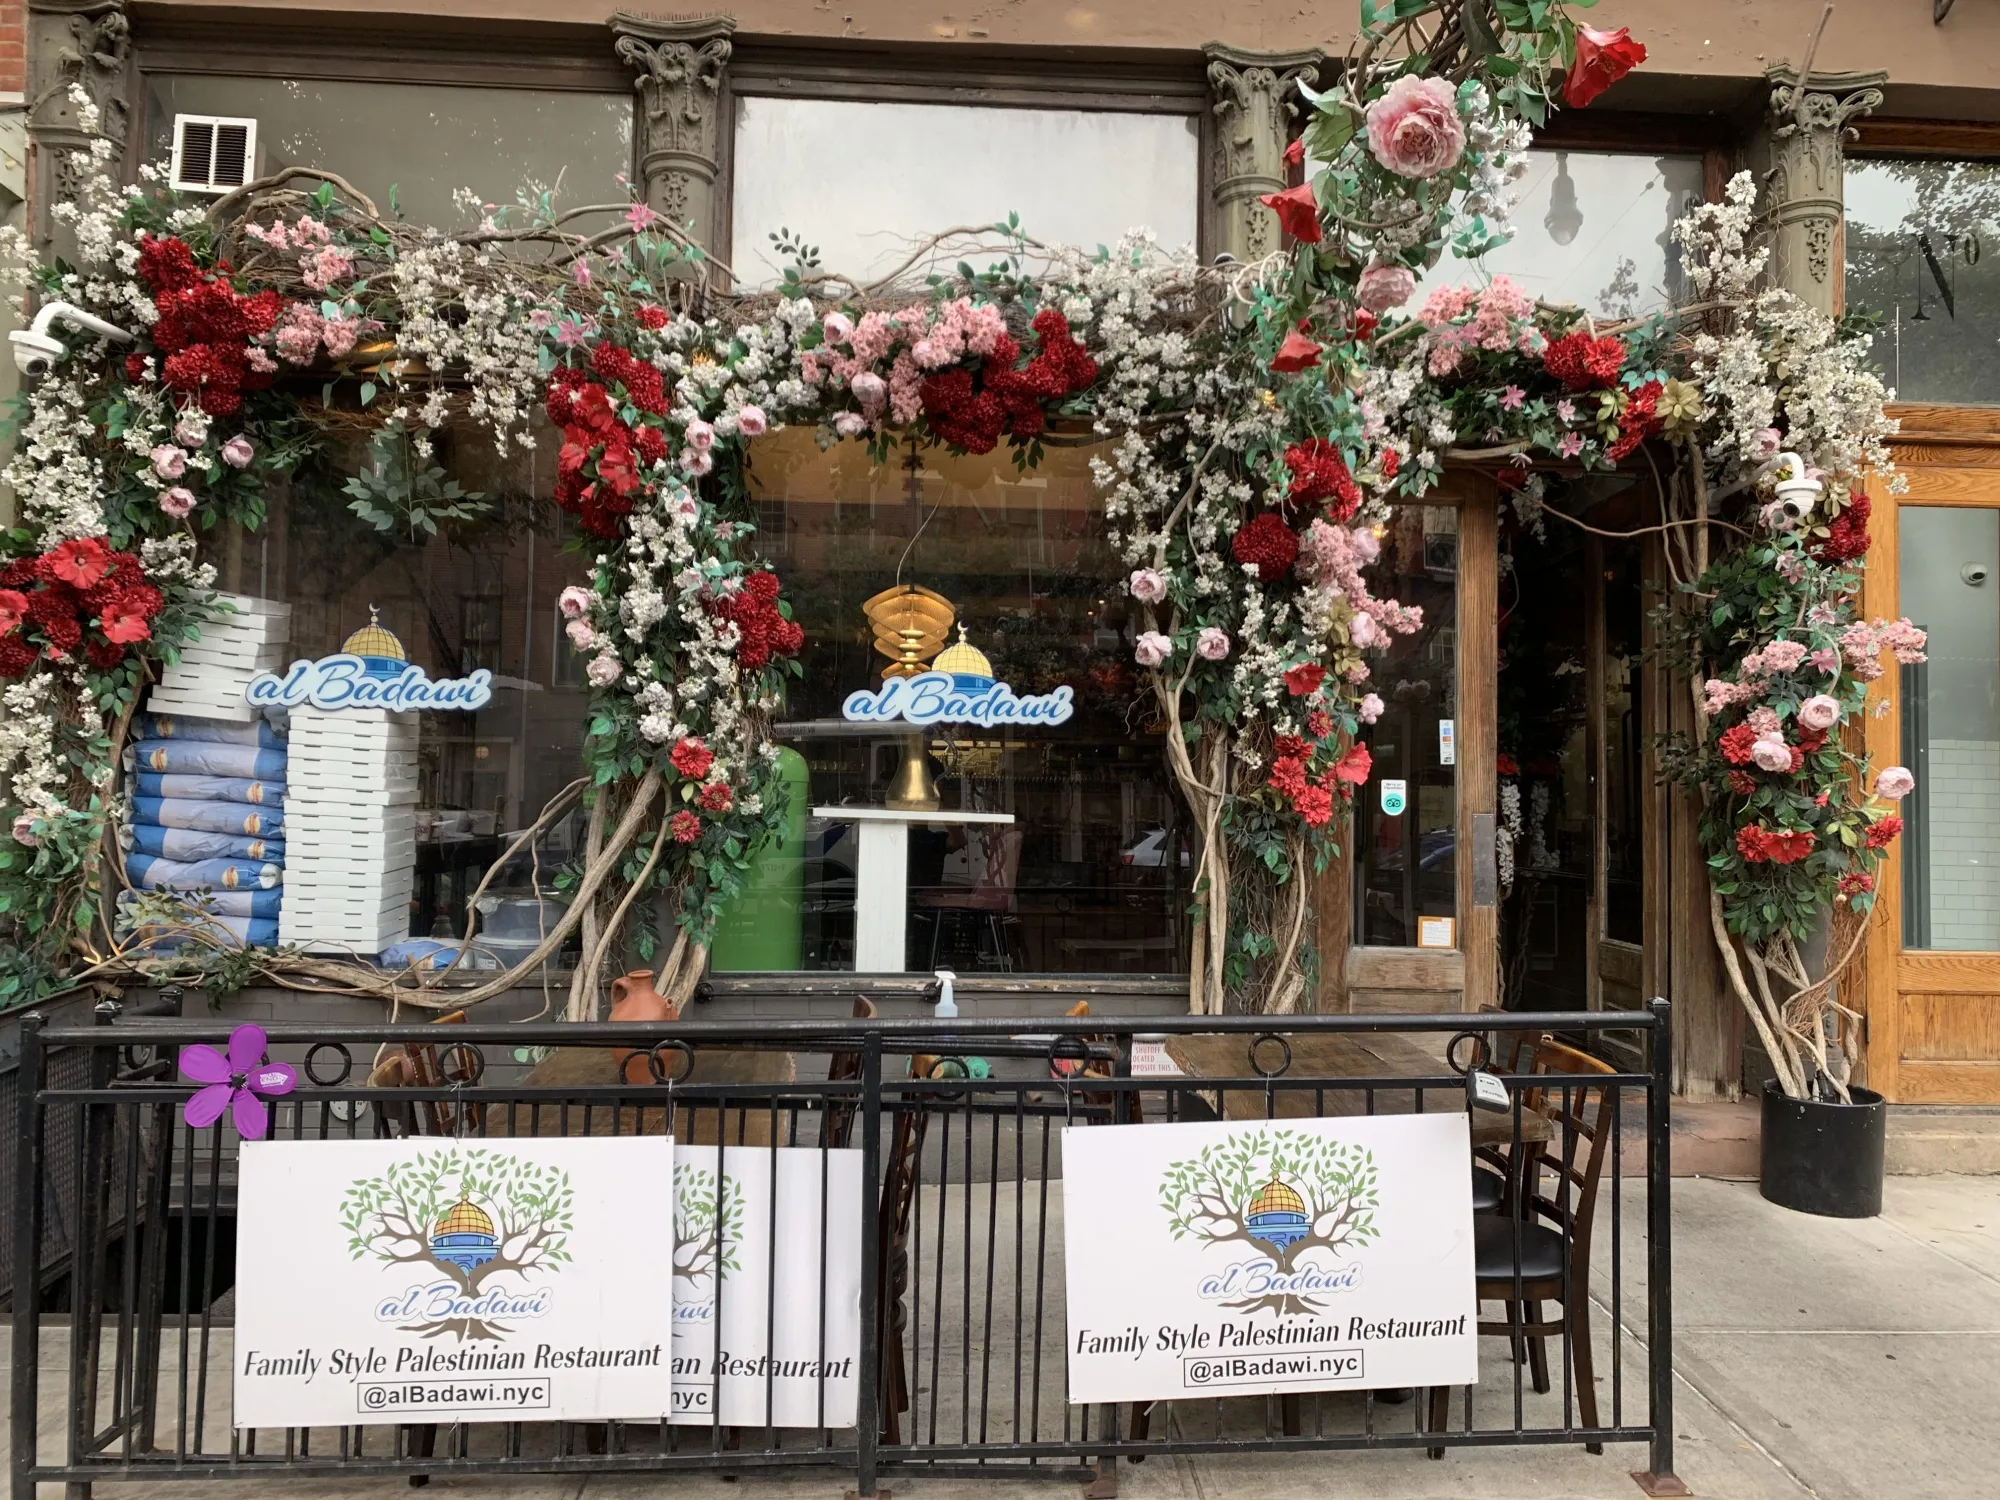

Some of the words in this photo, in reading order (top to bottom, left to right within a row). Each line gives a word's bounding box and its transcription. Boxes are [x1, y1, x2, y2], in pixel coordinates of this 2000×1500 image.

[251, 664, 309, 702] al
[315, 658, 486, 708] Badawi
[847, 681, 900, 717] al
[908, 675, 1068, 723] Badawi
[1131, 1064, 1156, 1072] PPOSITE
[1202, 1268, 1238, 1294] al
[1245, 1262, 1358, 1294] Badawi
[379, 1290, 420, 1317] al
[425, 1284, 549, 1318] Badawi
[1076, 1326, 1150, 1362] Family
[1156, 1323, 1211, 1359] Style
[1218, 1318, 1340, 1347] Palestinian
[1348, 1314, 1467, 1341] Restaurant
[243, 1348, 322, 1384] Family
[328, 1346, 387, 1383] Style
[395, 1344, 525, 1372] Palestinian
[533, 1343, 662, 1369] Restaurant
[1190, 1356, 1358, 1383] @alBadawi.nyc
[363, 1383, 544, 1409] @alBadawi.nyc
